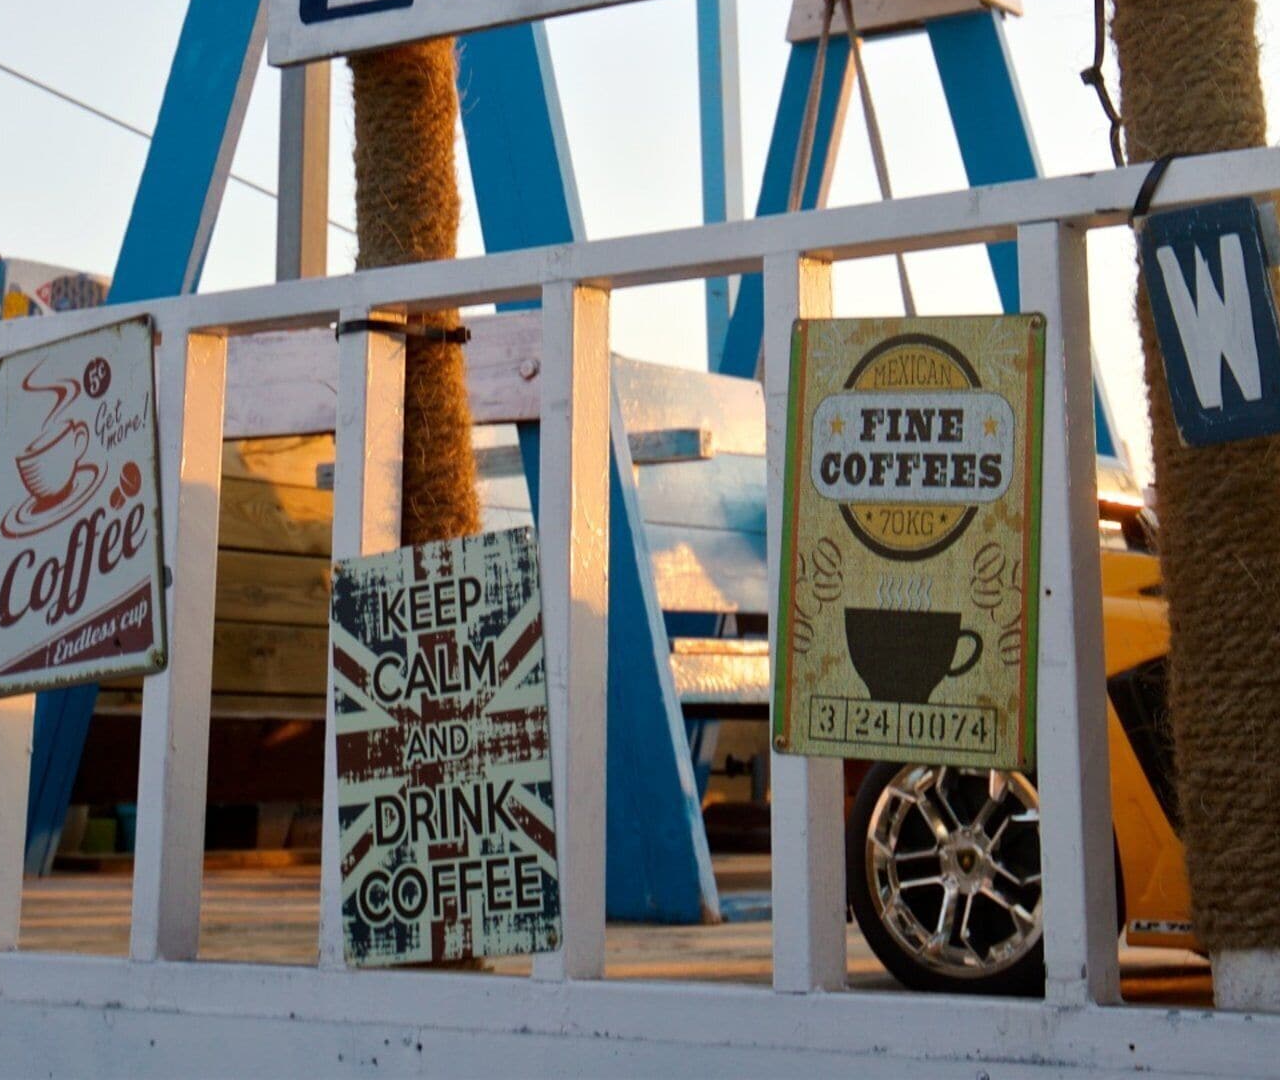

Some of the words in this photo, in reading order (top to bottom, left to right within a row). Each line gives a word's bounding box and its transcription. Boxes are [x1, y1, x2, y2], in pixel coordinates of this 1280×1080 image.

[874, 354, 952, 387] MEXICAN
[95, 399, 122, 446] Get
[106, 391, 149, 452] more!
[859, 408, 964, 443] FINE
[819, 452, 1003, 489] COFFEES
[879, 510, 934, 536] 70KG
[381, 576, 482, 638] KEEP
[52, 620, 116, 666] Endless
[120, 596, 149, 635] cup
[373, 642, 498, 703] CALM
[820, 700, 836, 732] 3
[855, 707, 890, 738] 24
[407, 725, 470, 762] AND
[374, 780, 518, 847] DRINK
[359, 856, 544, 922] COFFEE
